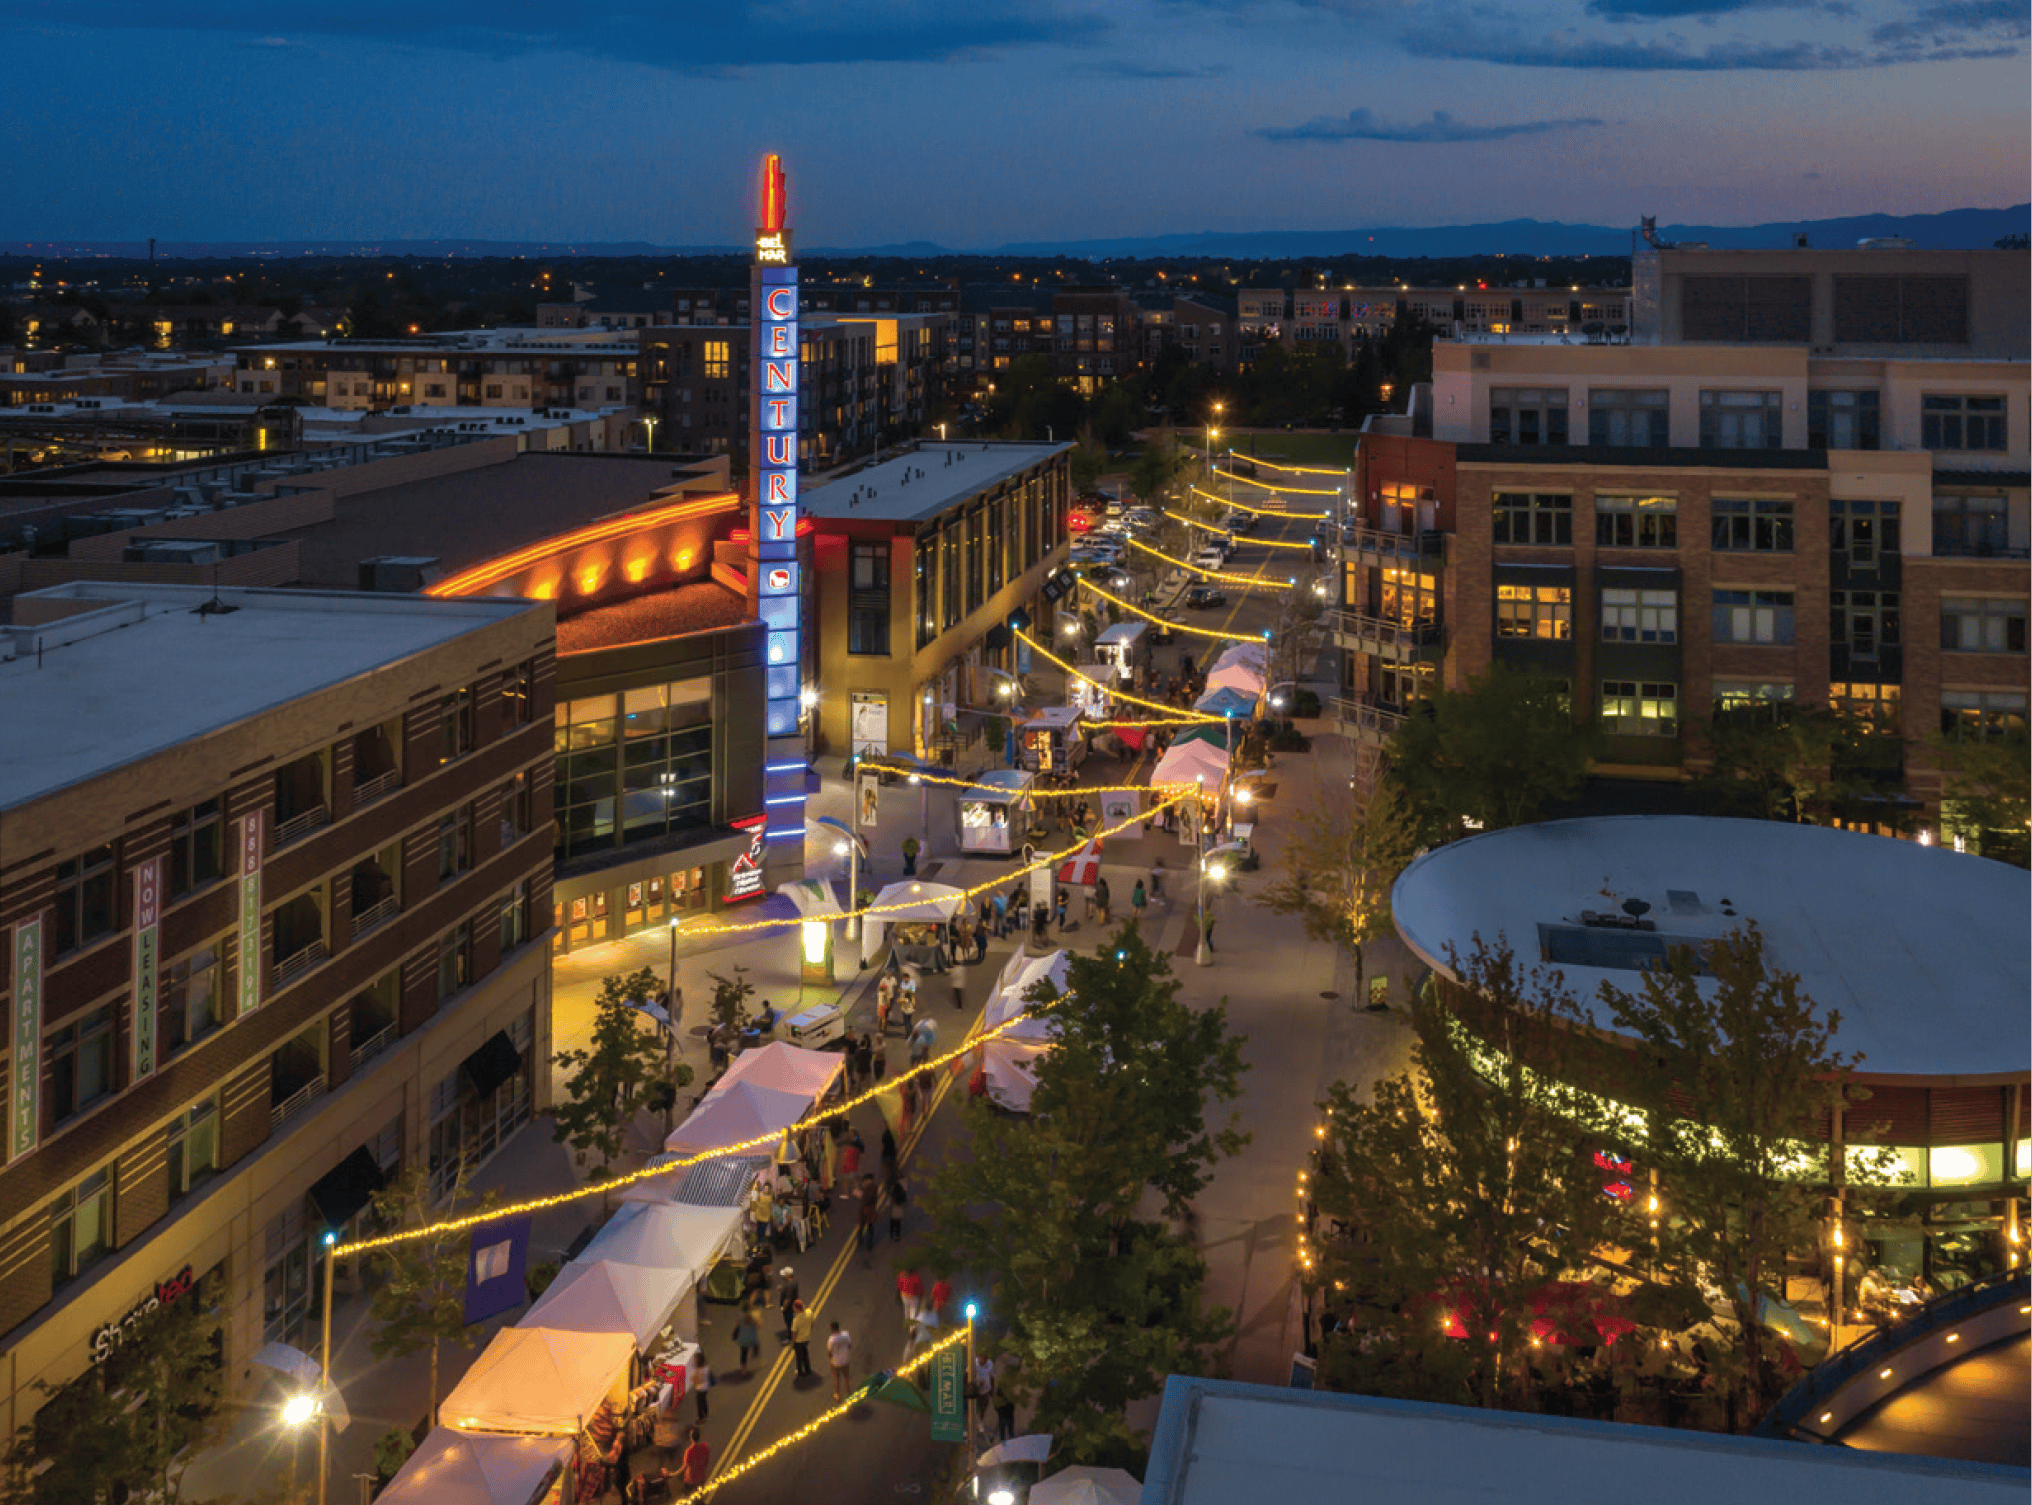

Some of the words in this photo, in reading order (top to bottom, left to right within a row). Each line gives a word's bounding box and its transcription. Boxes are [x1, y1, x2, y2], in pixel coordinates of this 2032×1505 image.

[766, 288, 792, 539] CENTURY
[140, 865, 154, 925] NOW
[19, 933, 34, 1149] APARTMENTS
[140, 934, 151, 1075] LEASING
